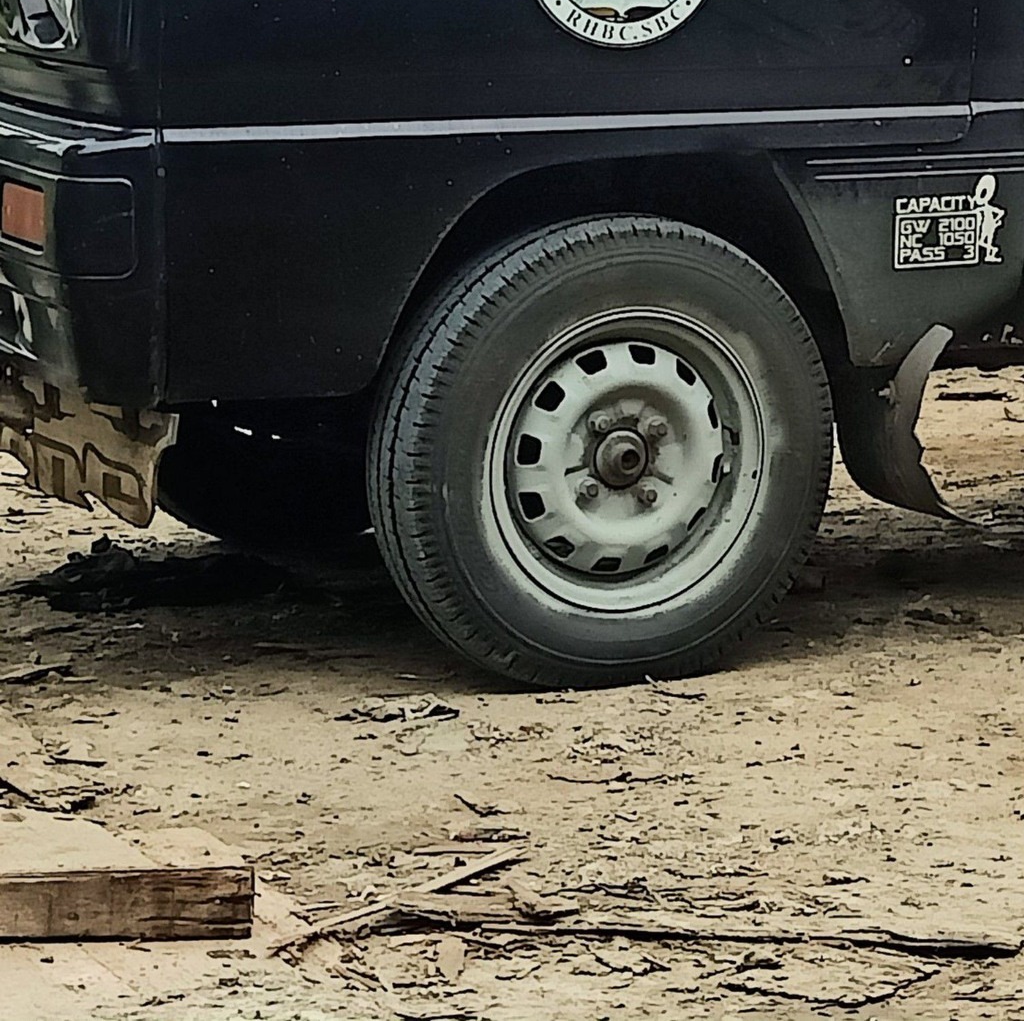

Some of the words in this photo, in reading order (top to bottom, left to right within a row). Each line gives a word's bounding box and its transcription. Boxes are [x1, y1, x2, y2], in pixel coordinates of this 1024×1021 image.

[896, 195, 976, 214] CAPACITY
[901, 218, 931, 235] GW
[938, 217, 976, 232] 2100
[900, 234, 923, 249] NC
[938, 231, 975, 246] 1050
[900, 246, 946, 263] PASS
[963, 245, 975, 259] 3
